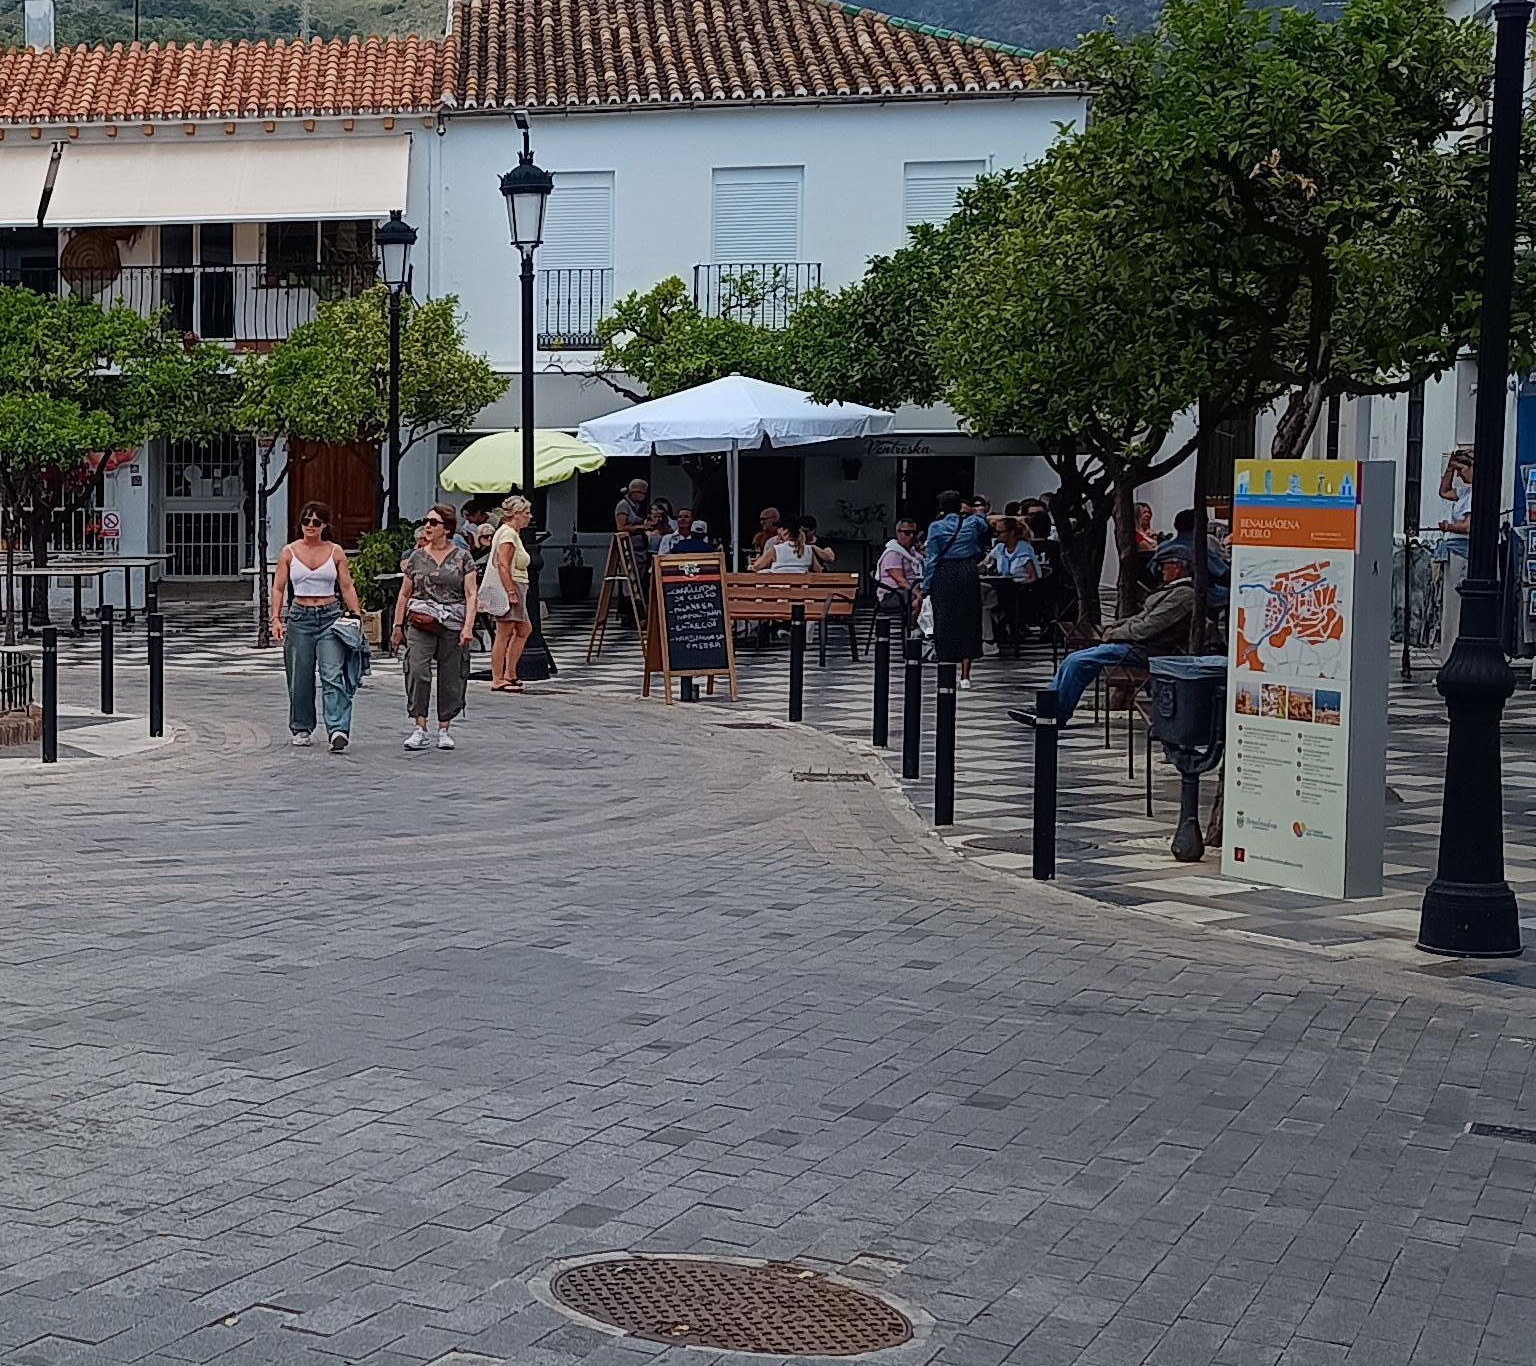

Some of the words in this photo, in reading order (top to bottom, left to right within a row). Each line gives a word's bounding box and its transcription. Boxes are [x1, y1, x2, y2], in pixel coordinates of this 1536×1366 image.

[864, 438, 933, 455] Ventreska
[1240, 517, 1300, 530] BENALMÁDENA
[1240, 528, 1271, 539] PUEBLO
